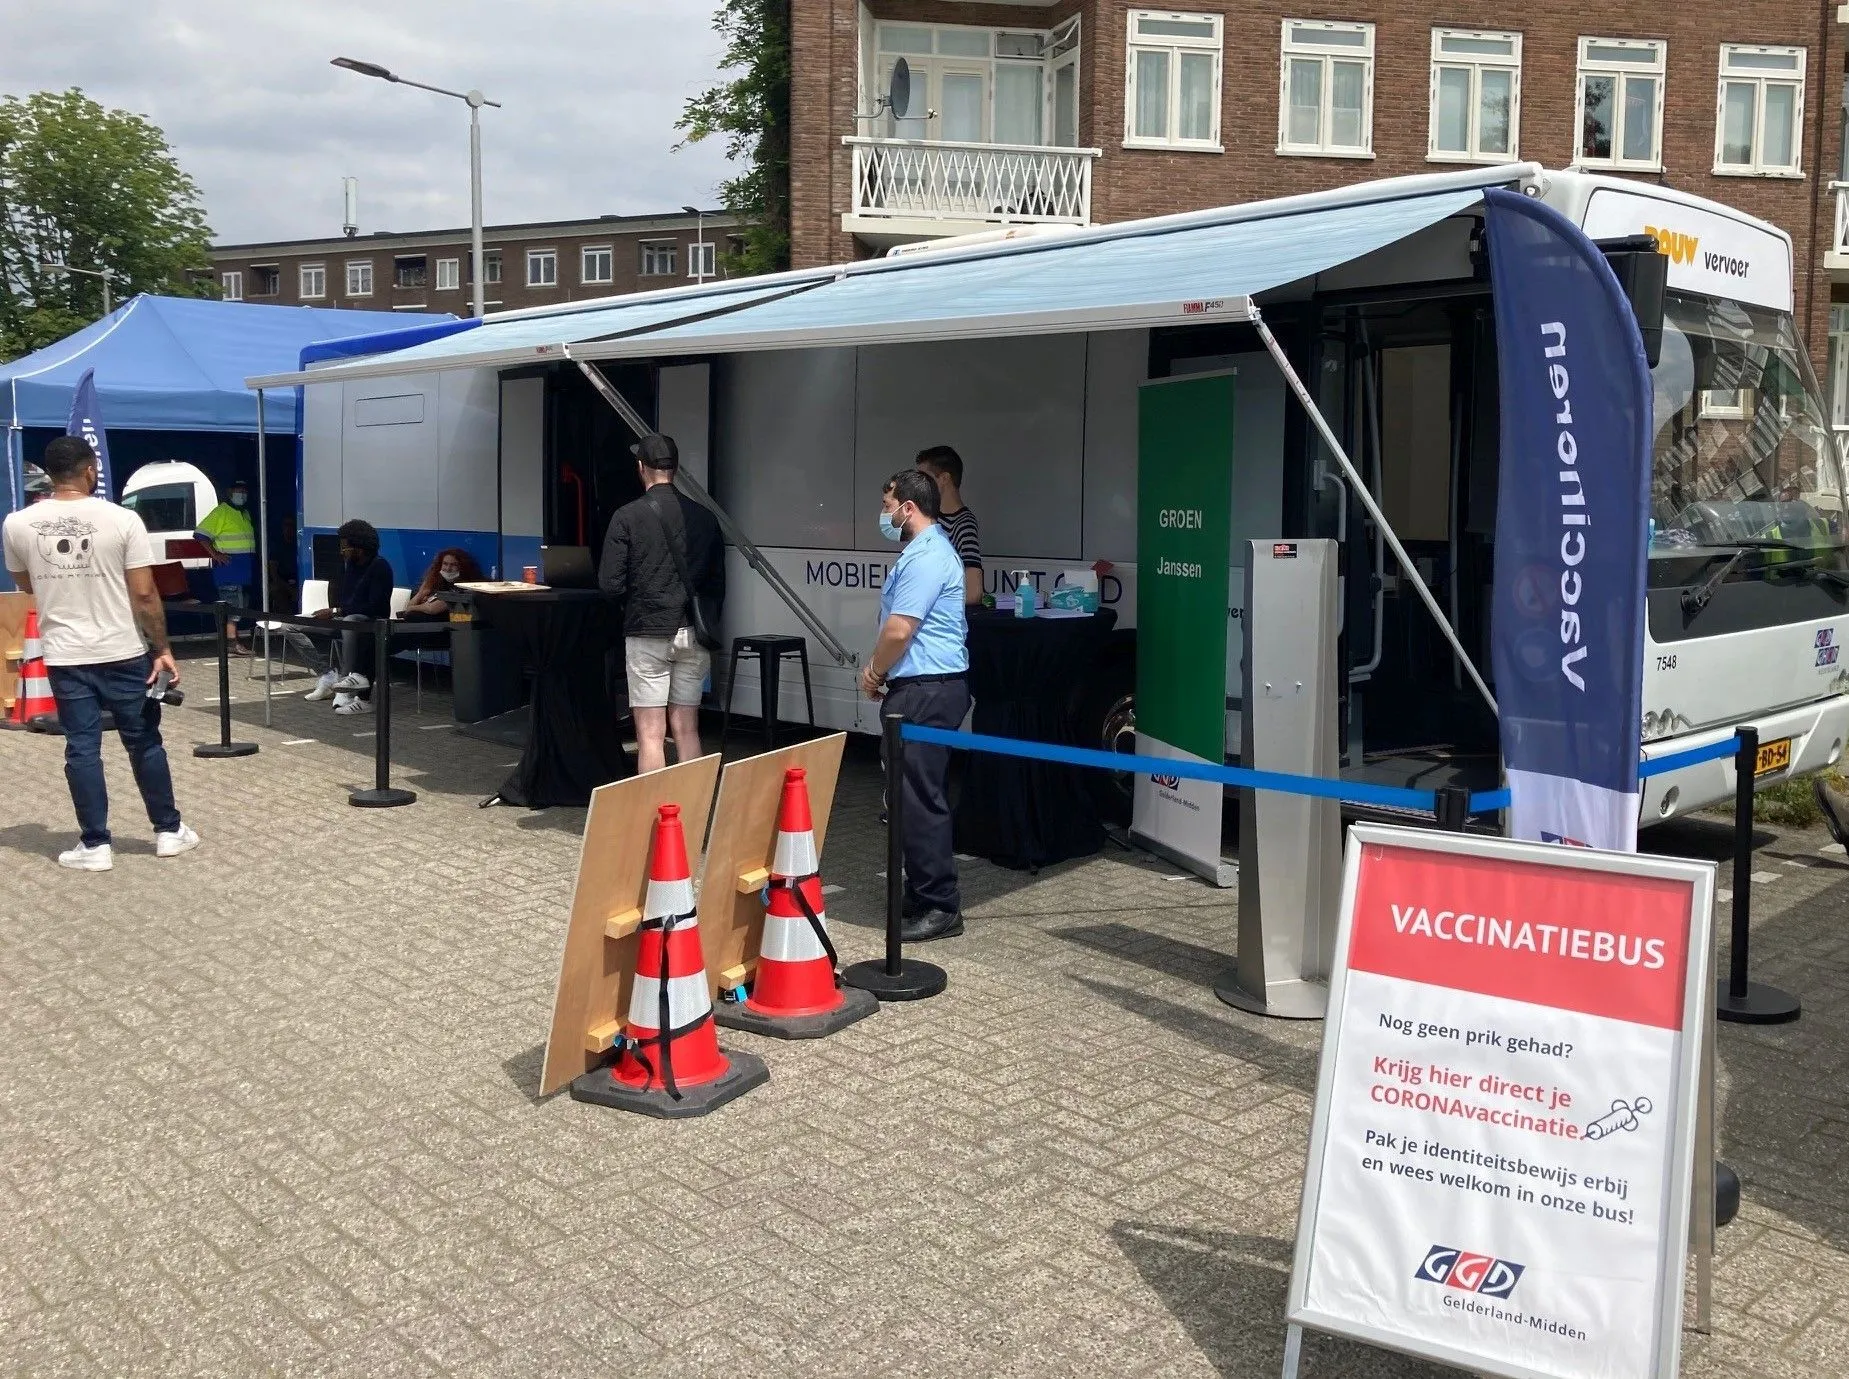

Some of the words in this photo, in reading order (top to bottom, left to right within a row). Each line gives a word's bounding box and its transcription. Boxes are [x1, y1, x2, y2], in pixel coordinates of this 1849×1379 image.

[1704, 252, 1750, 278] vervoer
[1159, 509, 1202, 529] GROEN
[982, 569, 1047, 594] UNT
[1157, 557, 1202, 578] Janssen
[1657, 655, 1677, 671] 7548
[1758, 743, 1788, 768] -BD-54
[1391, 904, 1665, 969] VACCINATIEBUS
[1379, 1013, 1414, 1036] Nog
[1417, 1022, 1460, 1041] geen
[1466, 1029, 1502, 1048] prik
[1506, 1035, 1574, 1059] gehad?
[1374, 1056, 1423, 1085] Krijg
[1429, 1064, 1473, 1089] hier
[1479, 1074, 1545, 1103] direct
[1548, 1087, 1572, 1111] je
[1365, 1129, 1397, 1150] Pak
[1400, 1136, 1418, 1155] je
[1423, 1140, 1577, 1187] identiteitsbewijs
[1583, 1175, 1629, 1201] erbij
[1361, 1156, 1383, 1172] en
[1389, 1160, 1434, 1182] wees
[1439, 1171, 1511, 1198] welkom
[1516, 1185, 1534, 1203] in
[1540, 1192, 1586, 1214] onze
[1592, 1200, 1635, 1225] bus!
[1423, 1249, 1517, 1294] GGD
[1443, 1295, 1586, 1341] Gelderland-Midden
